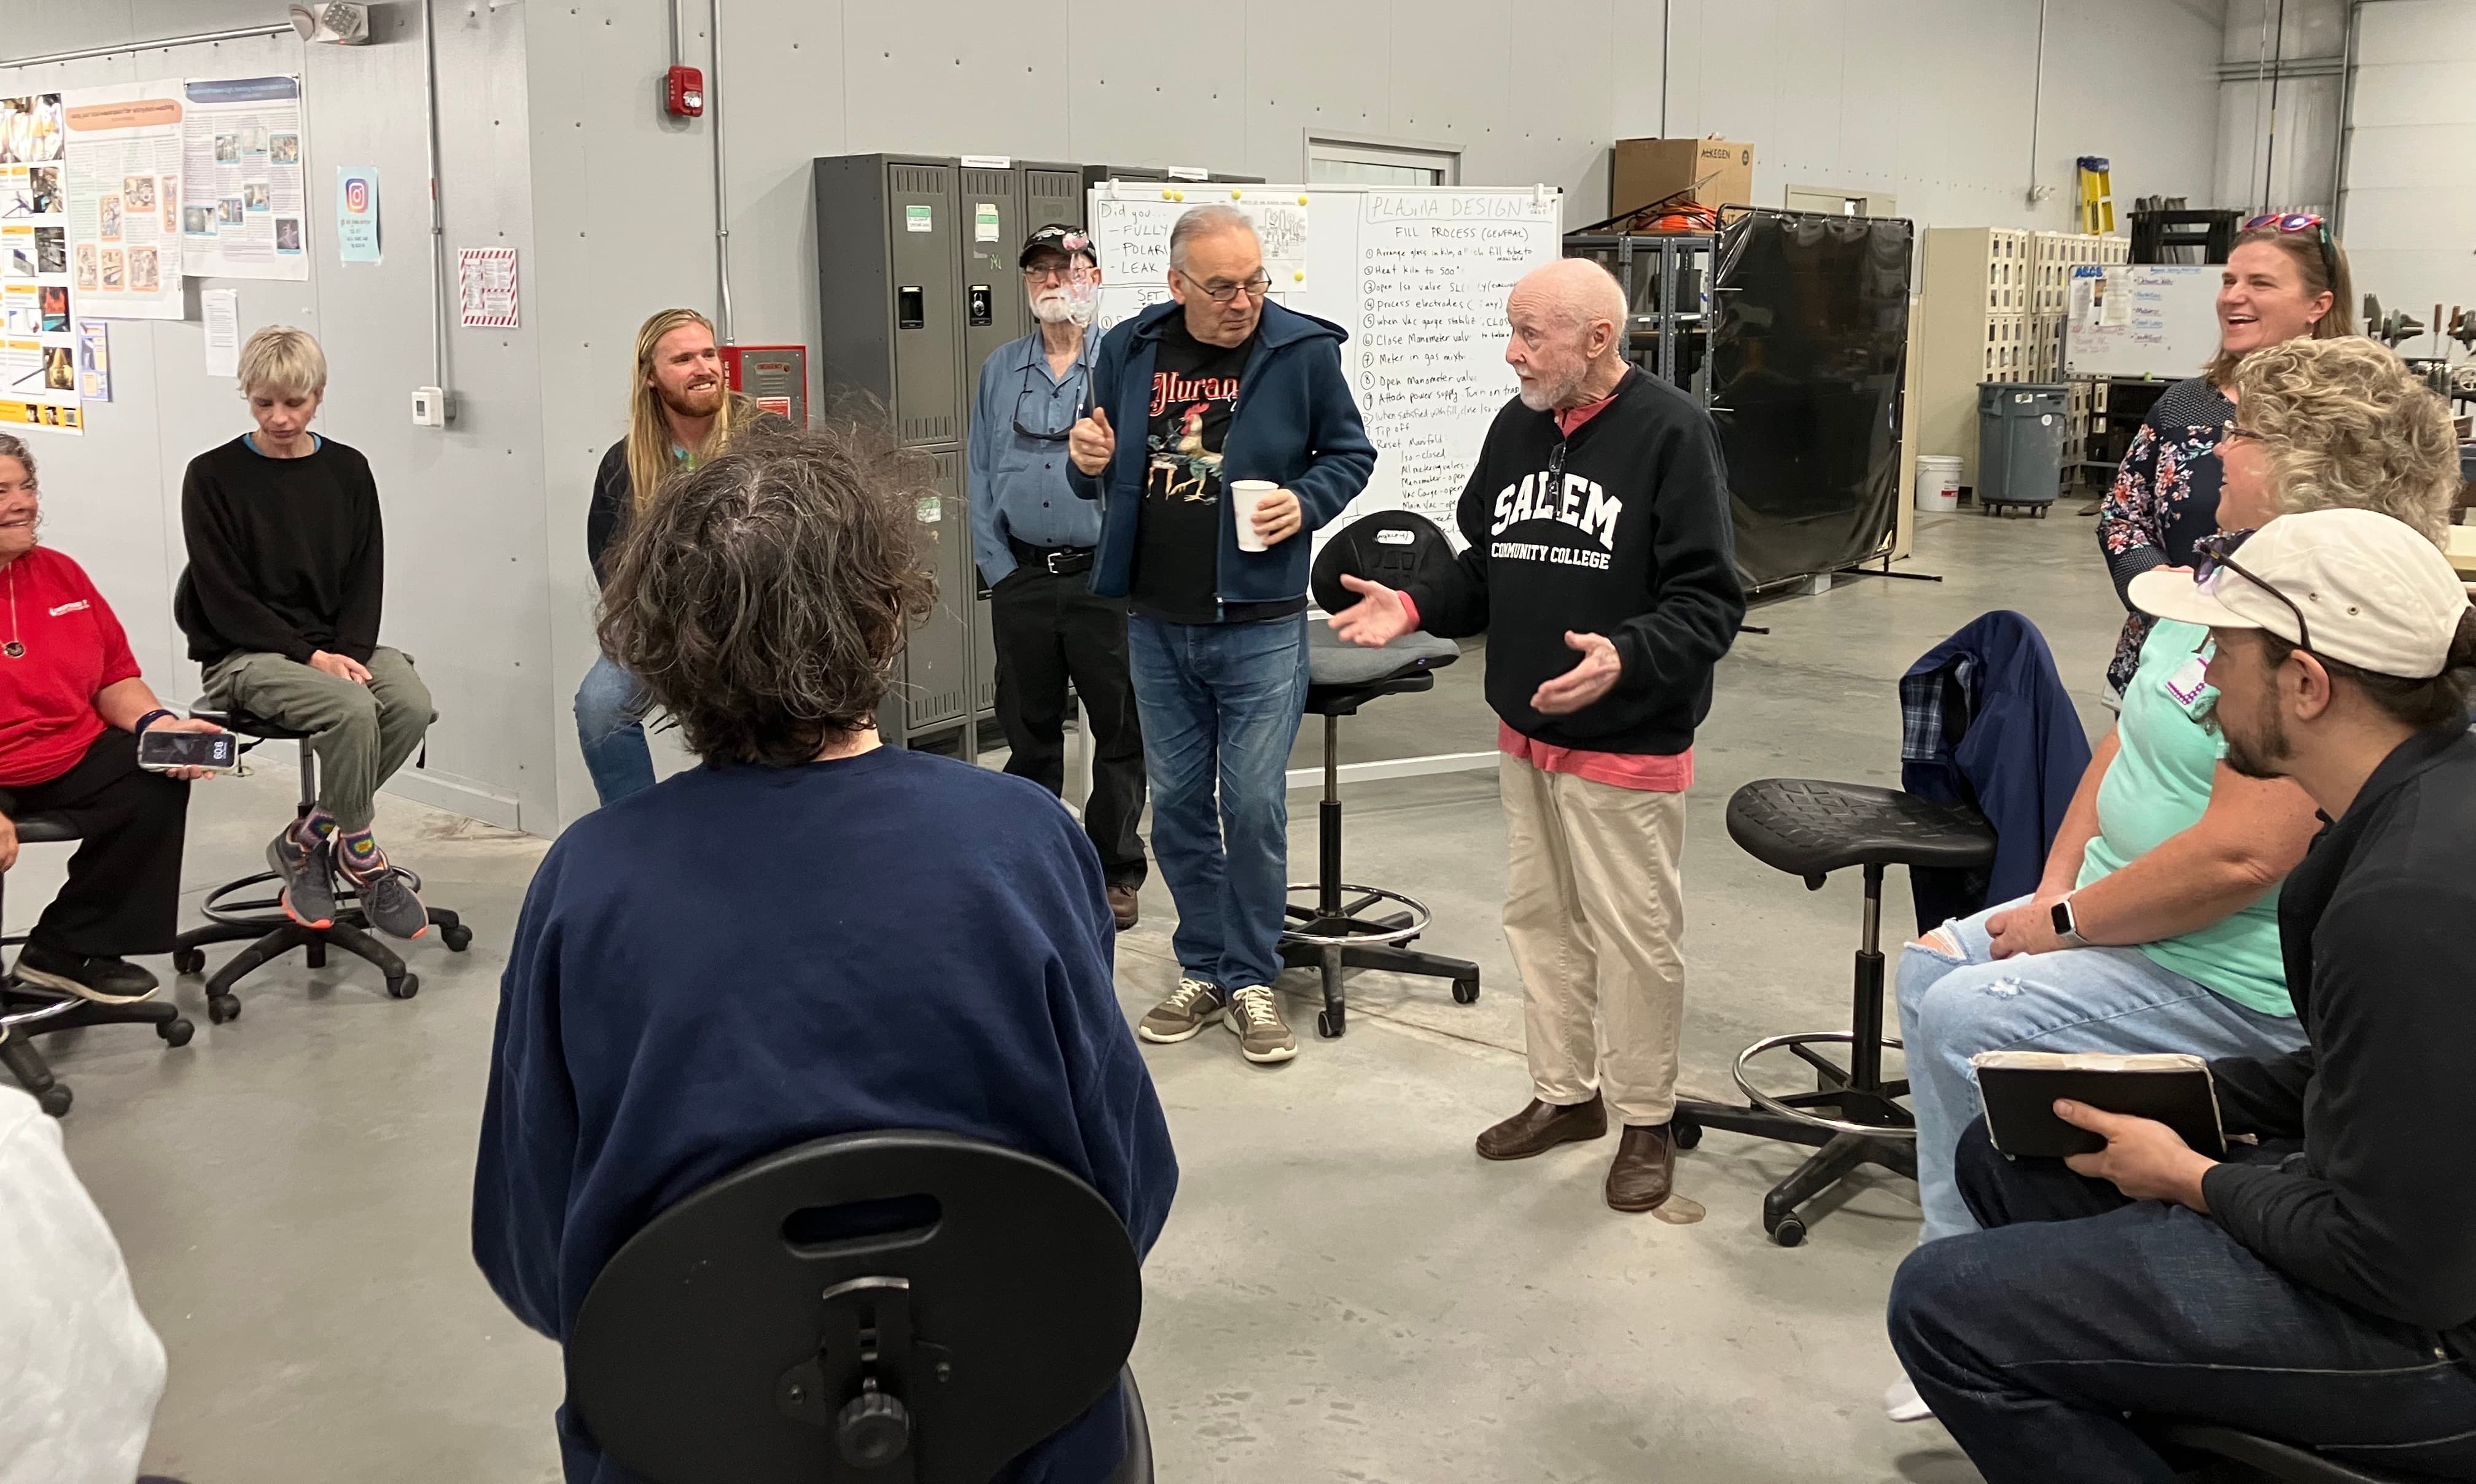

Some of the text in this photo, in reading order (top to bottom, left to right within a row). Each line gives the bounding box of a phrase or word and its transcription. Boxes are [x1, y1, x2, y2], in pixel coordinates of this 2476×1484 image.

[1101, 203, 1126, 217] Did
[1452, 197, 1522, 217] DESIGN
[1123, 224, 1168, 236] FULLY
[1395, 227, 1420, 238] FILL
[1431, 227, 1476, 238] PROCESS
[1376, 247, 1406, 261] Arrange
[1411, 247, 1427, 258] glass
[1489, 246, 1502, 256] fill
[1507, 246, 1523, 255] tube
[1122, 262, 1160, 274] LEAK
[1376, 264, 1397, 274] Heat
[1403, 265, 1419, 274] kiln
[1425, 266, 1434, 275] to
[1419, 281, 1441, 290] valve
[1137, 289, 1166, 302] SET
[1415, 298, 1463, 309] electrodes
[1376, 335, 1402, 346] Close
[1453, 330, 1471, 343] valv
[1379, 353, 1404, 365] Meter
[1425, 353, 1439, 367] gas
[1380, 376, 1401, 390] Open
[1379, 391, 1406, 405] Attach
[1410, 391, 1433, 403] power
[1489, 389, 1500, 397] on
[1376, 423, 1410, 438] Tip off
[1377, 438, 1402, 449] Reset
[1491, 471, 1623, 551] SALEM
[1491, 542, 1611, 570] COMMUNITY COLLEGE
